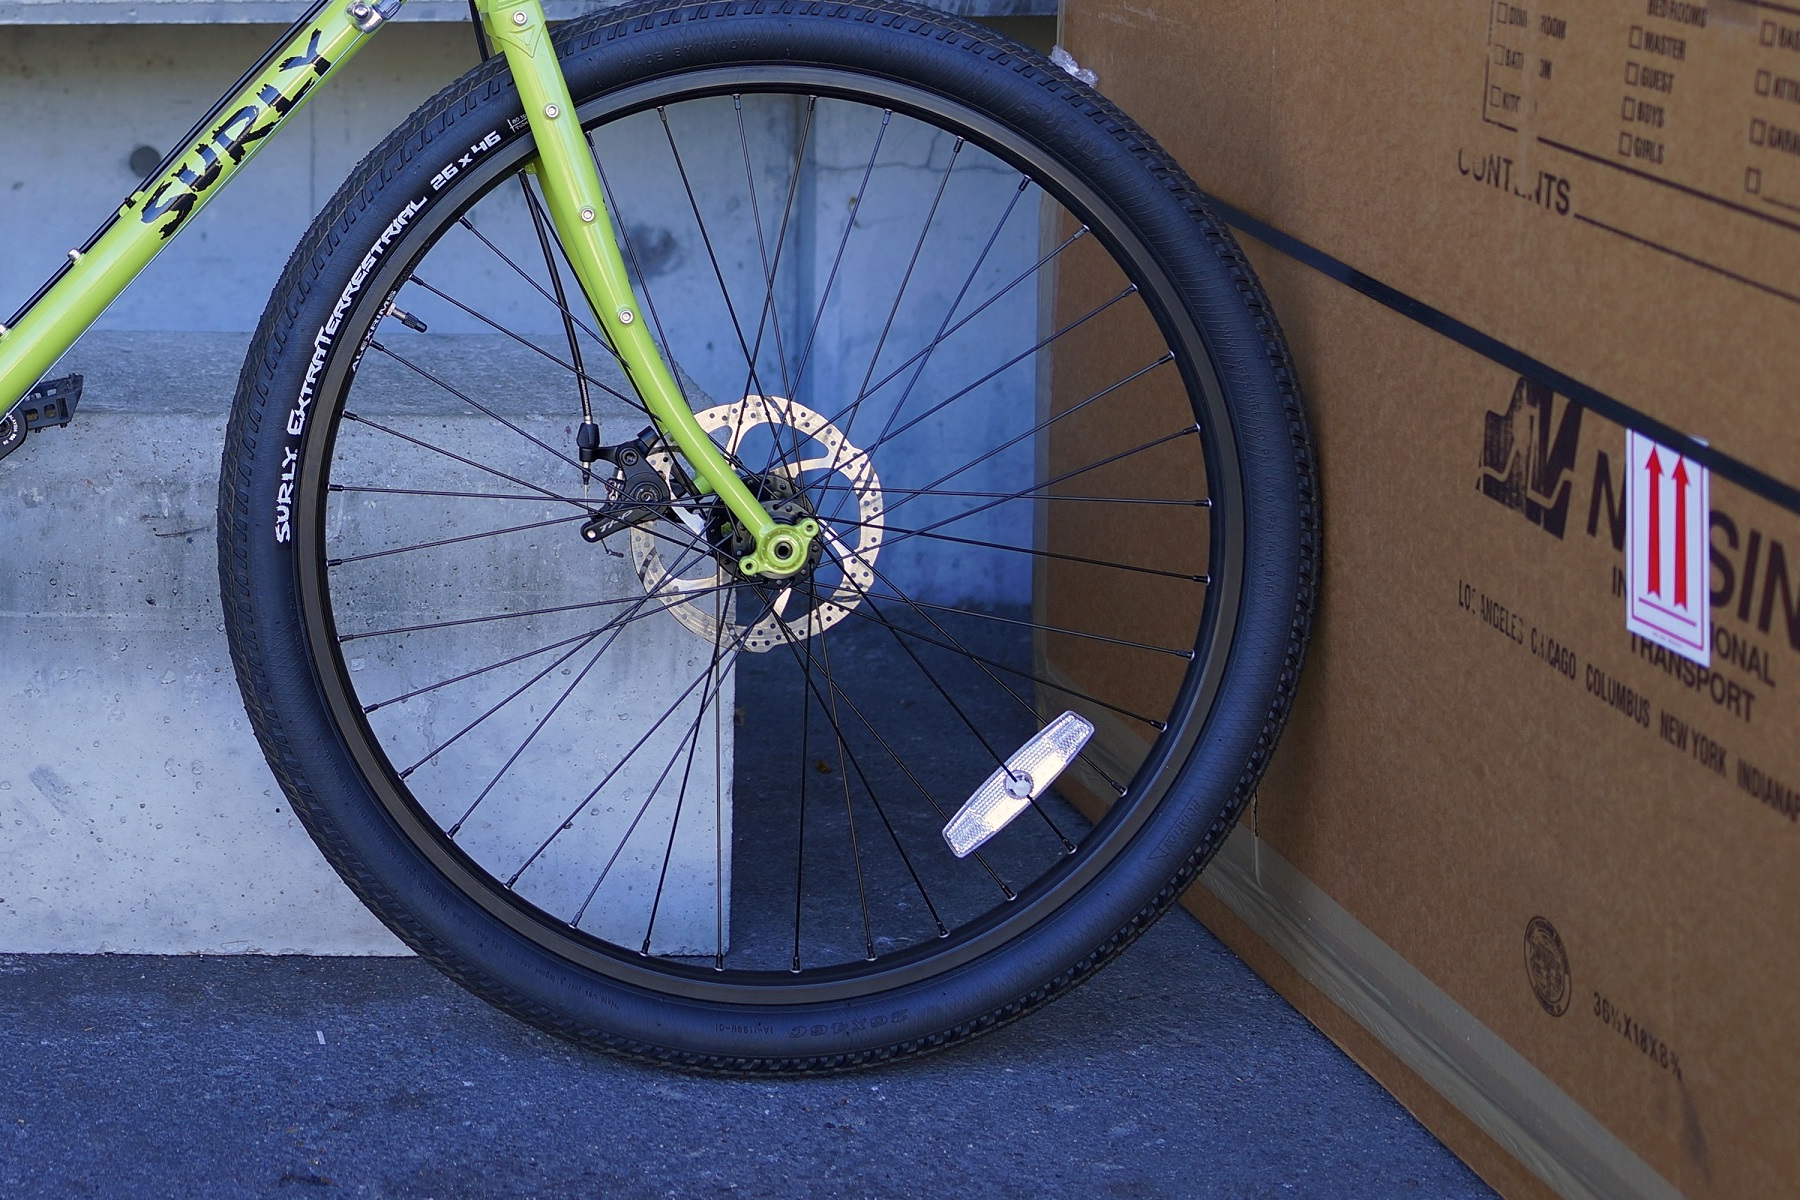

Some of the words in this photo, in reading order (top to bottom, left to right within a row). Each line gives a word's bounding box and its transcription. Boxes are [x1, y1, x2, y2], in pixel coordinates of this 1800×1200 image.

[1644, 31, 1686, 62] MASTER
[1640, 66, 1674, 96] GUEST
[1638, 101, 1665, 128] BOYS
[141, 28, 332, 240] SURLY
[1634, 137, 1665, 165] GIRLS
[275, 446, 298, 544] SURLY
[430, 166, 459, 192] 26
[470, 130, 501, 154] 46
[1586, 664, 1650, 729] COLUMBUS
[1660, 709, 1689, 752] NEW
[1688, 723, 1728, 777] YORK
